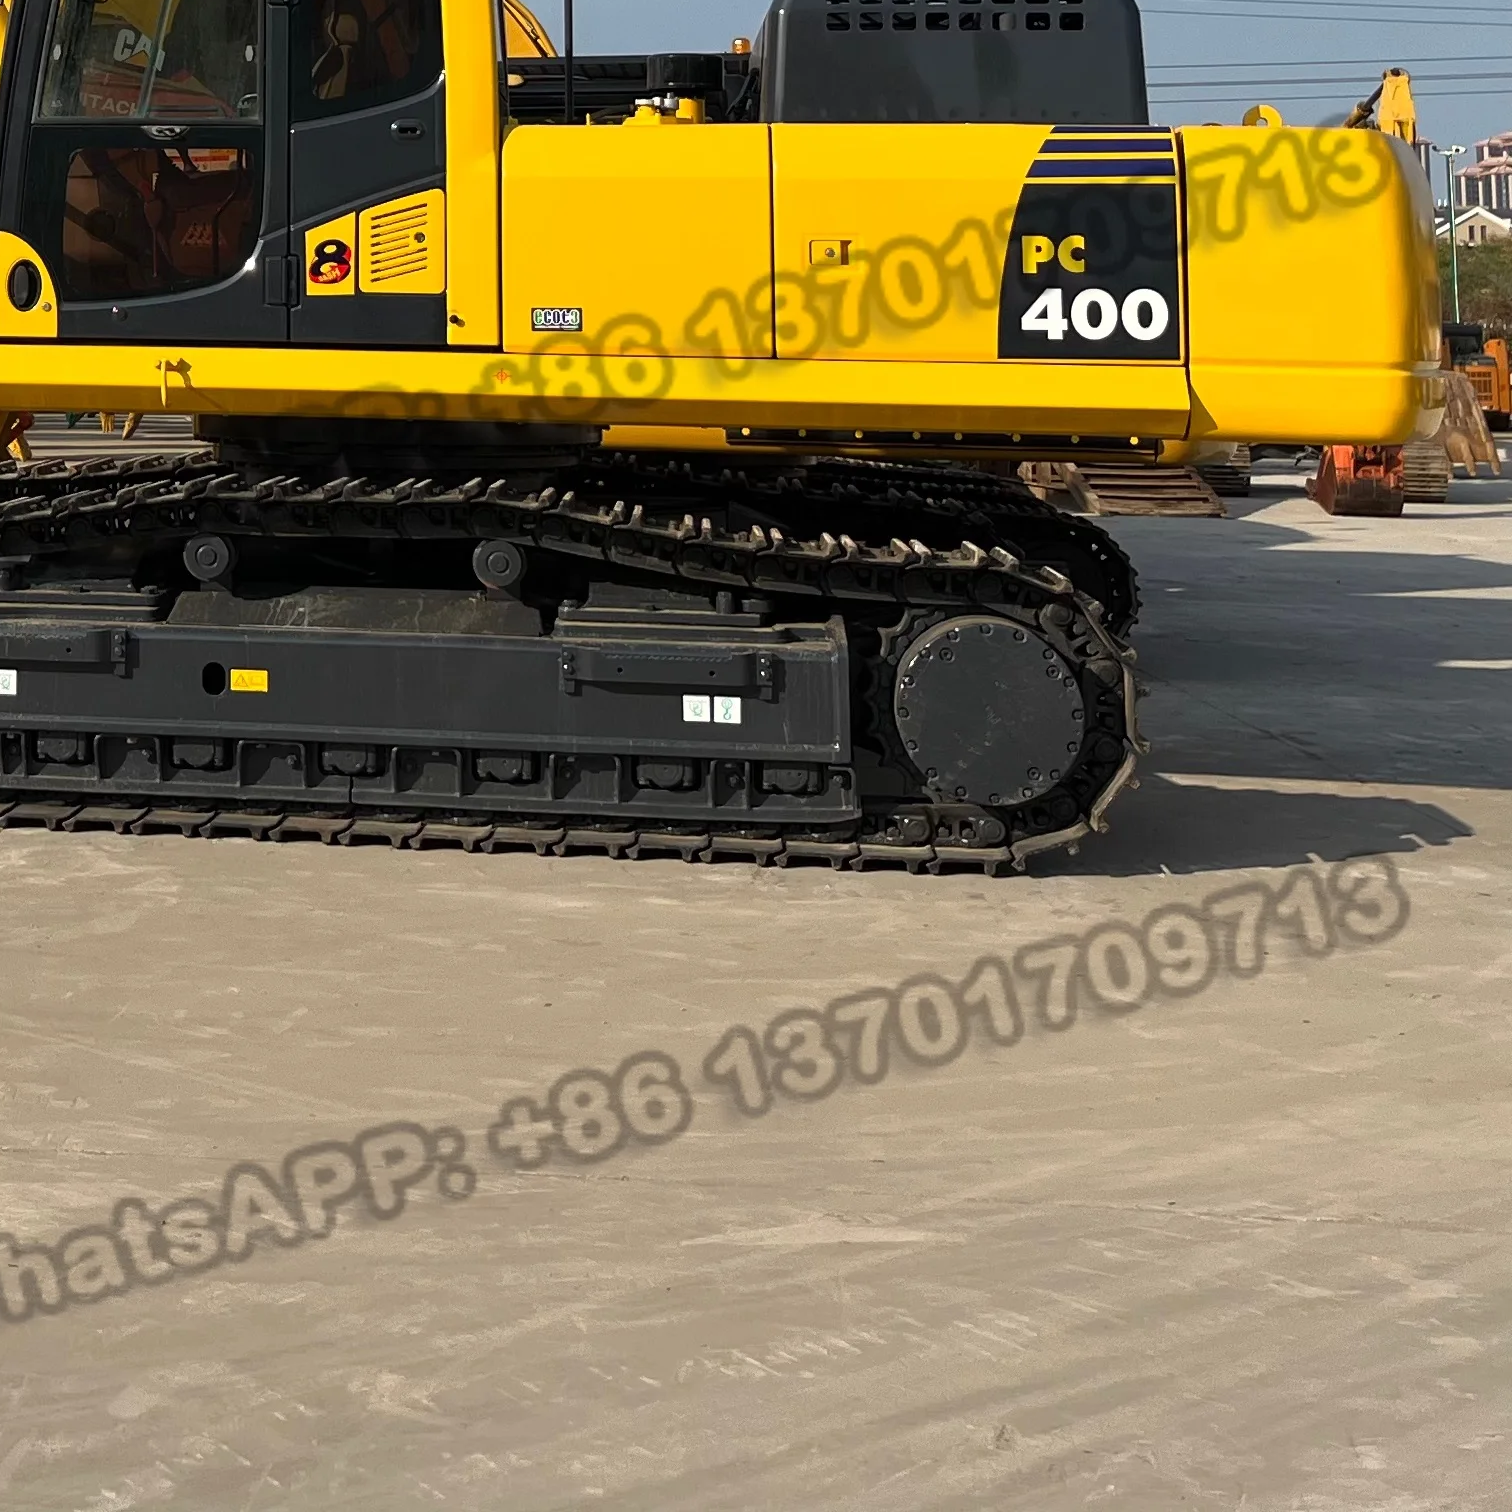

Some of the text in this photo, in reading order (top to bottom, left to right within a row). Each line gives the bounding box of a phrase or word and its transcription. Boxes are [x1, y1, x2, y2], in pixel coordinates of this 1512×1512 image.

[309, 239, 351, 284] 8
[1021, 235, 1085, 274] PC
[1020, 288, 1169, 341] 400
